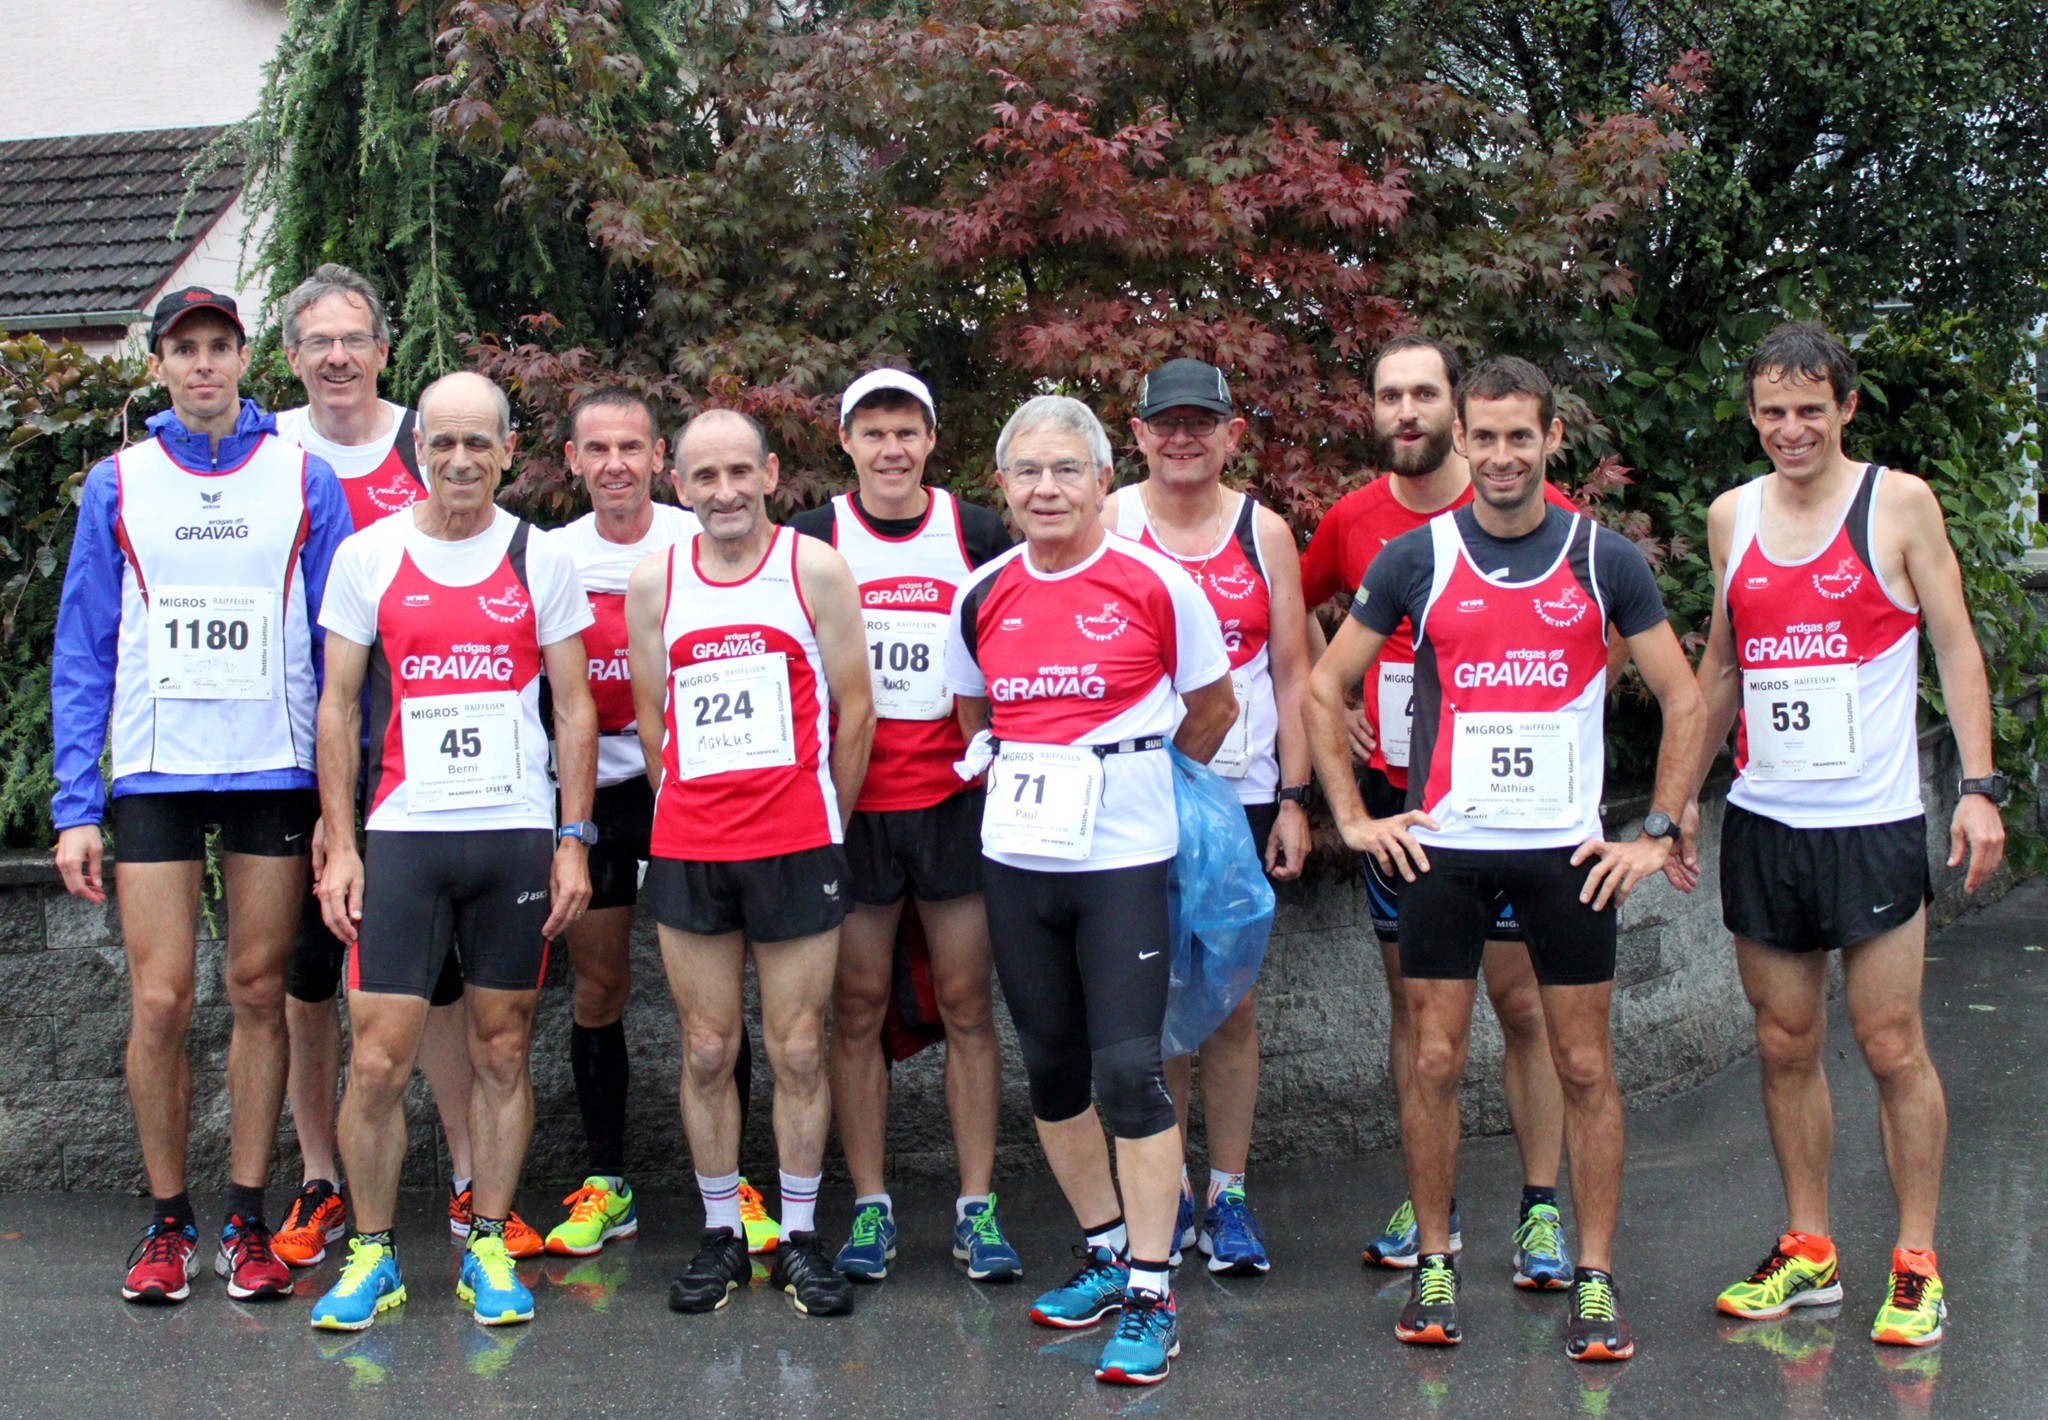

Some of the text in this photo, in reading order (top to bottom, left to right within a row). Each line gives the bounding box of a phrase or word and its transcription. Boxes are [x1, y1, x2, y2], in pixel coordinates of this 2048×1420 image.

[366, 486, 416, 511] RHEINTAL
[175, 525, 249, 540] GRAVAG
[898, 582, 922, 590] erdgas
[1209, 574, 1255, 599] RHEINTAL
[1218, 576, 1248, 584] MILA
[1812, 572, 1862, 599] RHEINTAL
[159, 598, 255, 608] MIGROS RAIFFEISEN
[487, 598, 521, 607] MILA
[865, 588, 938, 604] GRAVAG
[1543, 601, 1578, 609] MILA
[478, 595, 528, 623] RHEINTAL
[1533, 599, 1586, 627] RHEINTAL
[165, 619, 249, 650] 1180
[724, 632, 750, 641] erdgas
[1075, 614, 1129, 641] RHEINTAL
[1786, 622, 1823, 634] erdgas
[451, 643, 491, 655] erdgas
[692, 639, 766, 659] GRAVAG
[870, 641, 930, 672] 108
[1506, 648, 1546, 660] erdgas
[1745, 634, 1848, 662] GRAVAG
[401, 655, 514, 681] GRAVAG
[1039, 664, 1078, 677] erdgas
[1454, 661, 1569, 688] GRAVAG
[680, 673, 719, 689] MIGROS
[725, 666, 766, 676] RAIFFEISEN
[1384, 673, 1413, 684] MIGRO
[1750, 677, 1836, 691] MIGROS RAIFFEISEN
[992, 676, 1106, 701] GRAVAG
[411, 707, 459, 720] MIGROS
[464, 703, 505, 712] RAIFFEISEN
[694, 690, 754, 727] 224
[1772, 700, 1811, 732] 53
[1466, 725, 1513, 735] MIGROS
[440, 727, 482, 759] 45
[698, 733, 752, 752] Markus
[1001, 752, 1081, 762] MIGROS RAIFFEISEN
[1491, 747, 1534, 777] 55
[448, 763, 478, 774] Berni
[1014, 773, 1046, 804] 71
[1490, 783, 1535, 793] Mathias
[1015, 809, 1037, 819] Paul
